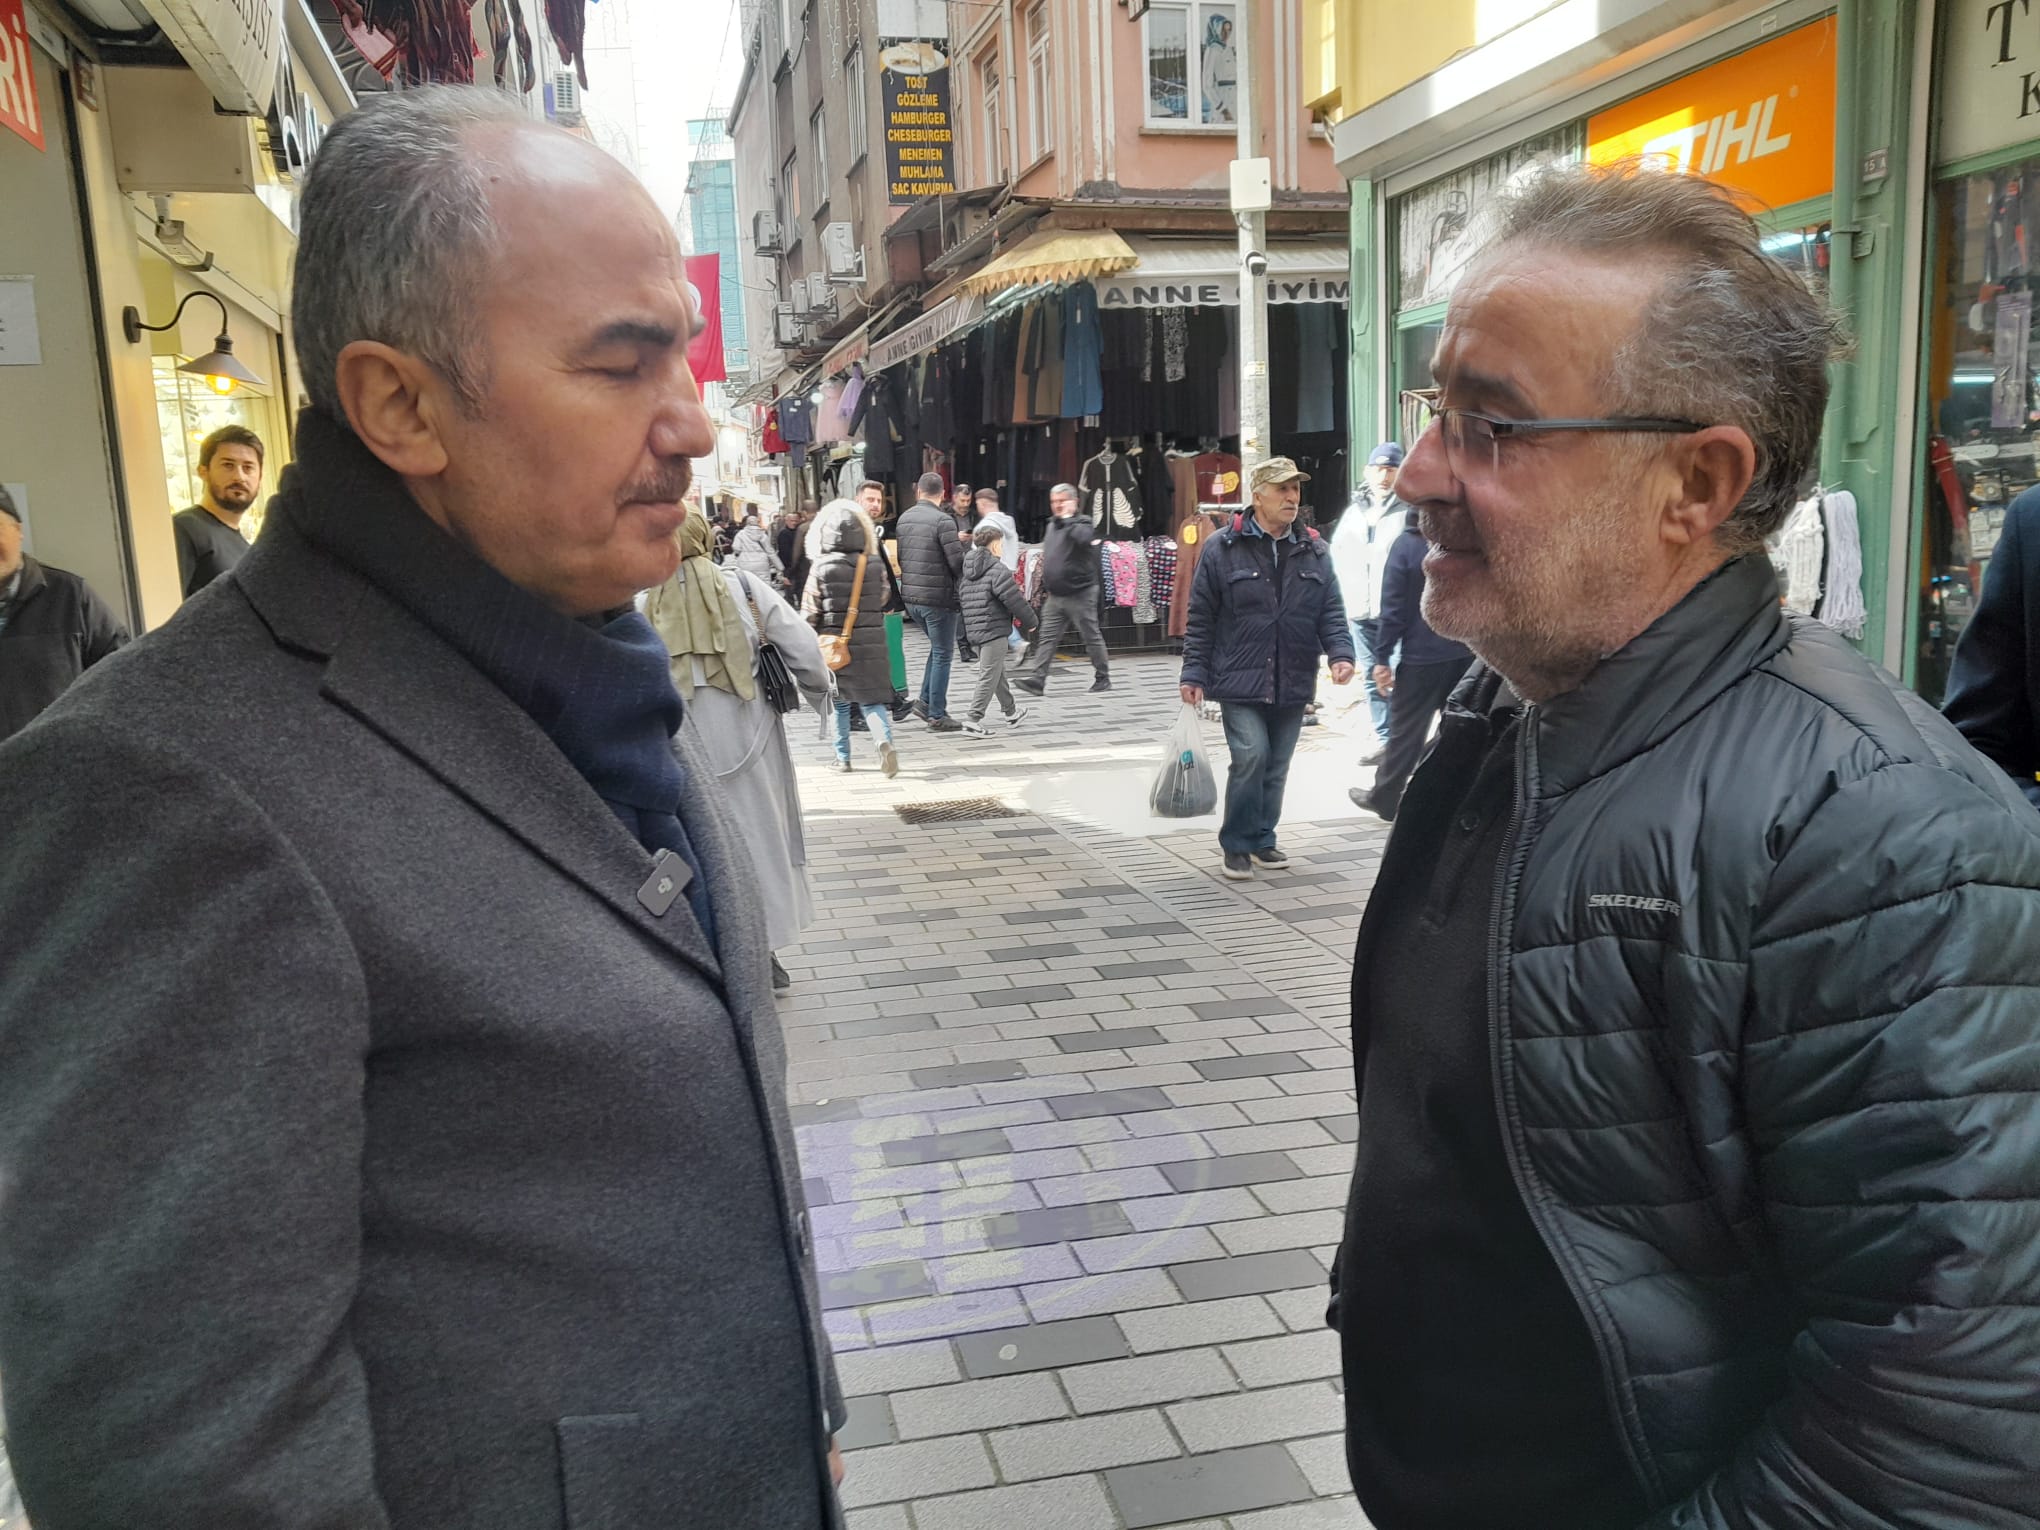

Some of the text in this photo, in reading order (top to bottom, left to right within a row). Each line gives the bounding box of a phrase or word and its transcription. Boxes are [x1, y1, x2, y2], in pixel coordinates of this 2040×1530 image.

[905, 76, 928, 89] TOST
[897, 91, 938, 106] GÖZLEME
[891, 112, 945, 124] HAMBURGER
[888, 129, 951, 142] CHESEBURGER
[1638, 94, 1792, 176] STIHL
[899, 148, 942, 160] MENEMEN
[900, 166, 944, 178] MUHLAMA
[892, 182, 954, 195] SAC KAVURMA
[1103, 277, 1350, 305] ANNE İYİM
